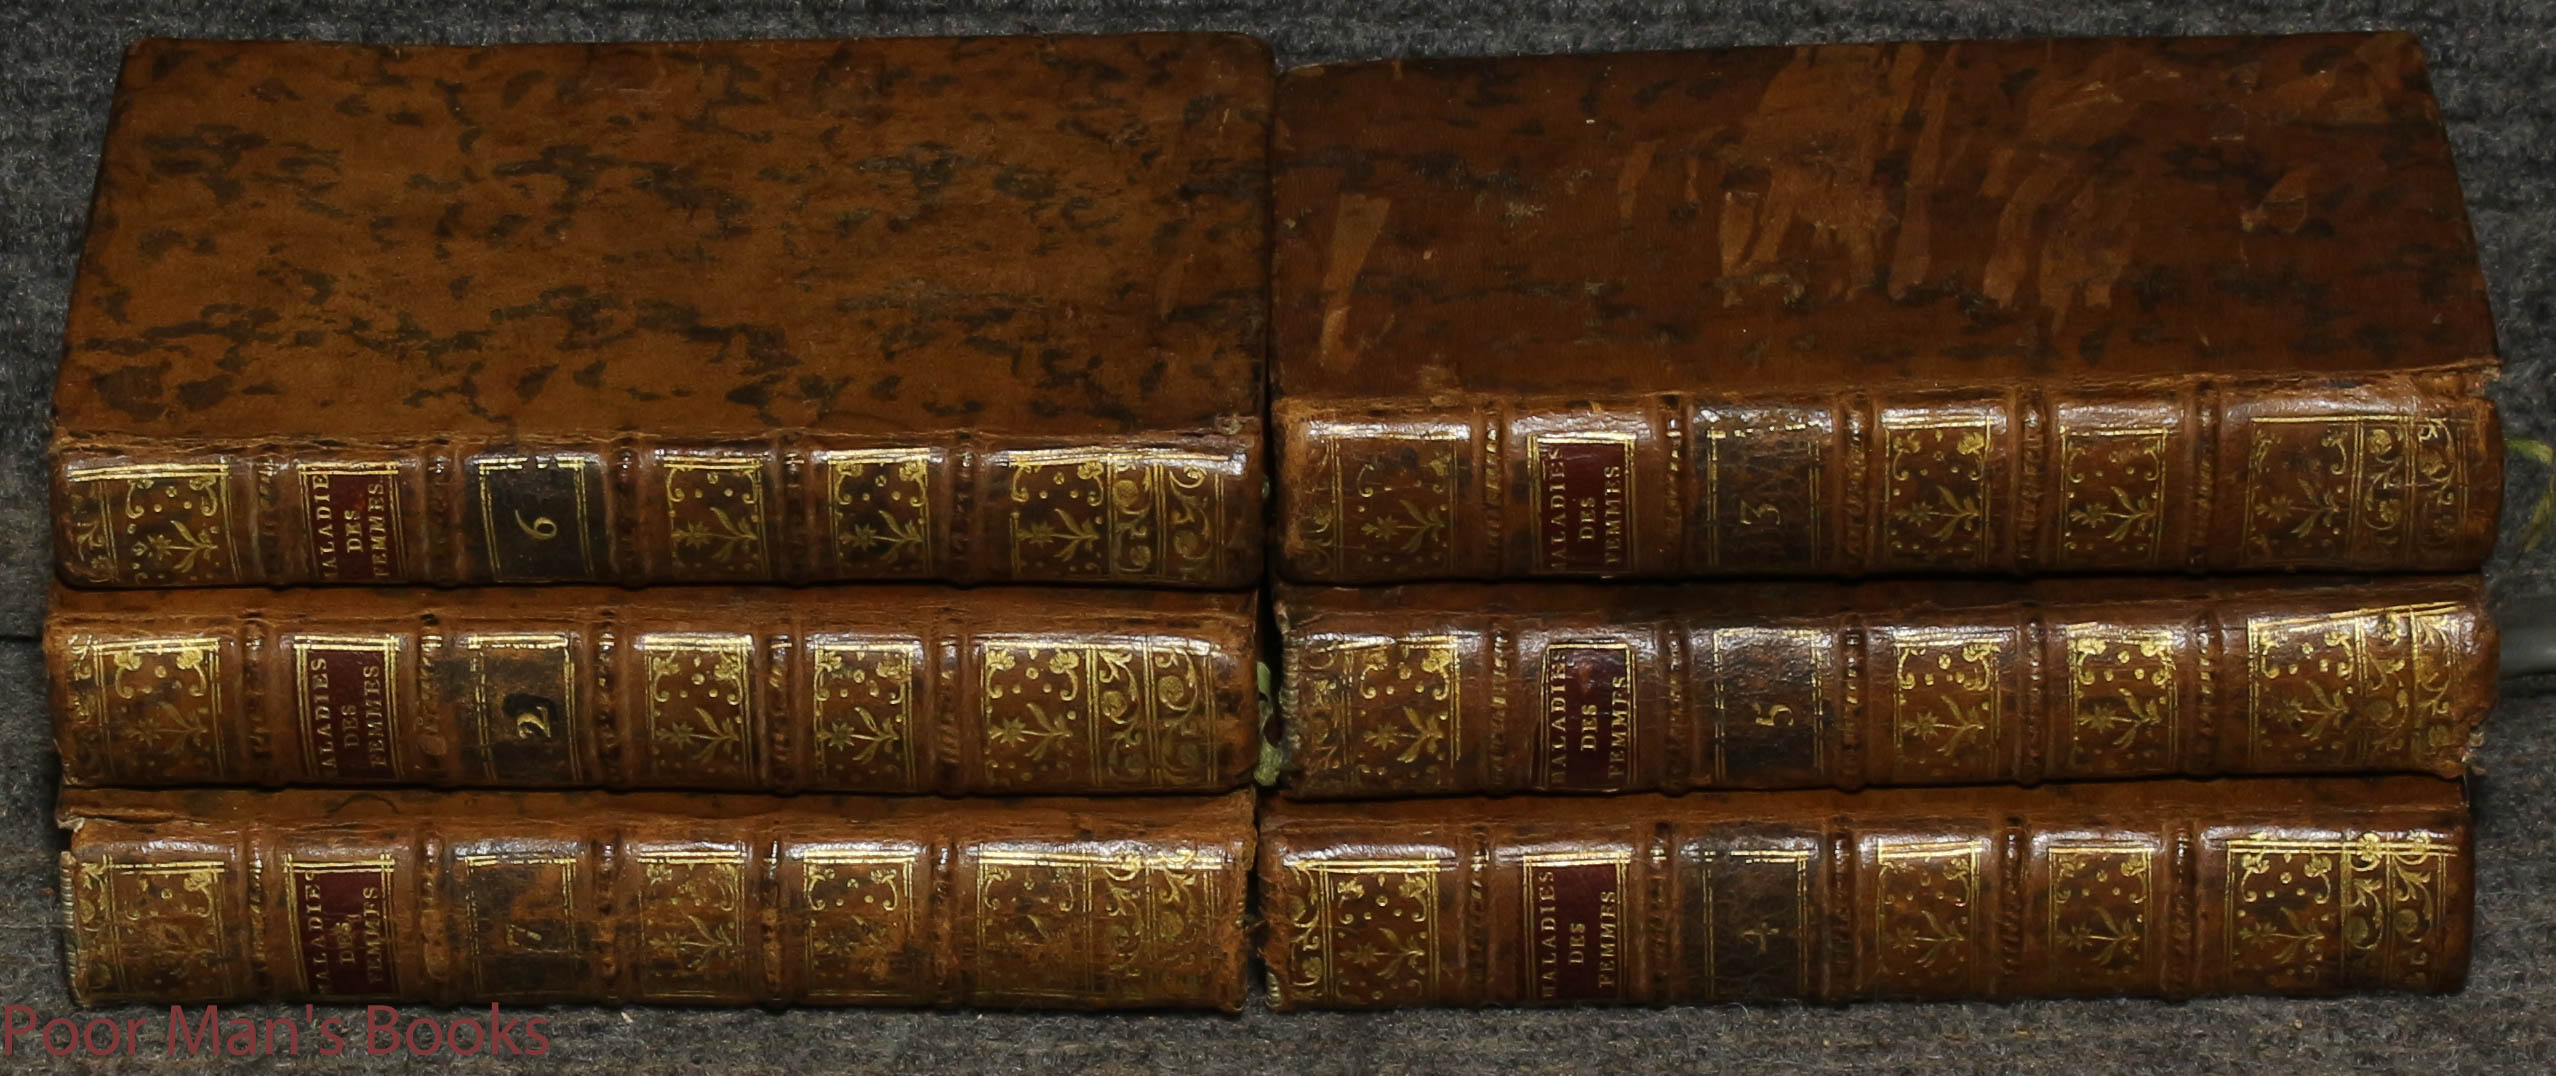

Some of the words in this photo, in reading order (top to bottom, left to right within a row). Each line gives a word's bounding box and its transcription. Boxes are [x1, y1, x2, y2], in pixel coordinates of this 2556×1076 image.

[344, 510, 364, 553] DES
[514, 509, 557, 540] 6
[1579, 497, 1596, 542] DES
[1604, 465, 1622, 565] FEMMES
[1741, 500, 1781, 525] 3
[342, 704, 359, 748] DES
[363, 665, 388, 768] FEMMES
[516, 705, 552, 740] 2
[1581, 704, 1597, 751] DES
[1608, 676, 1629, 778] FEMMES
[1753, 702, 1794, 727] 5
[336, 922, 357, 966] DES
[363, 886, 384, 984] FEMMES
[1569, 923, 1586, 966] DES
[1600, 890, 1617, 988] FEMMES
